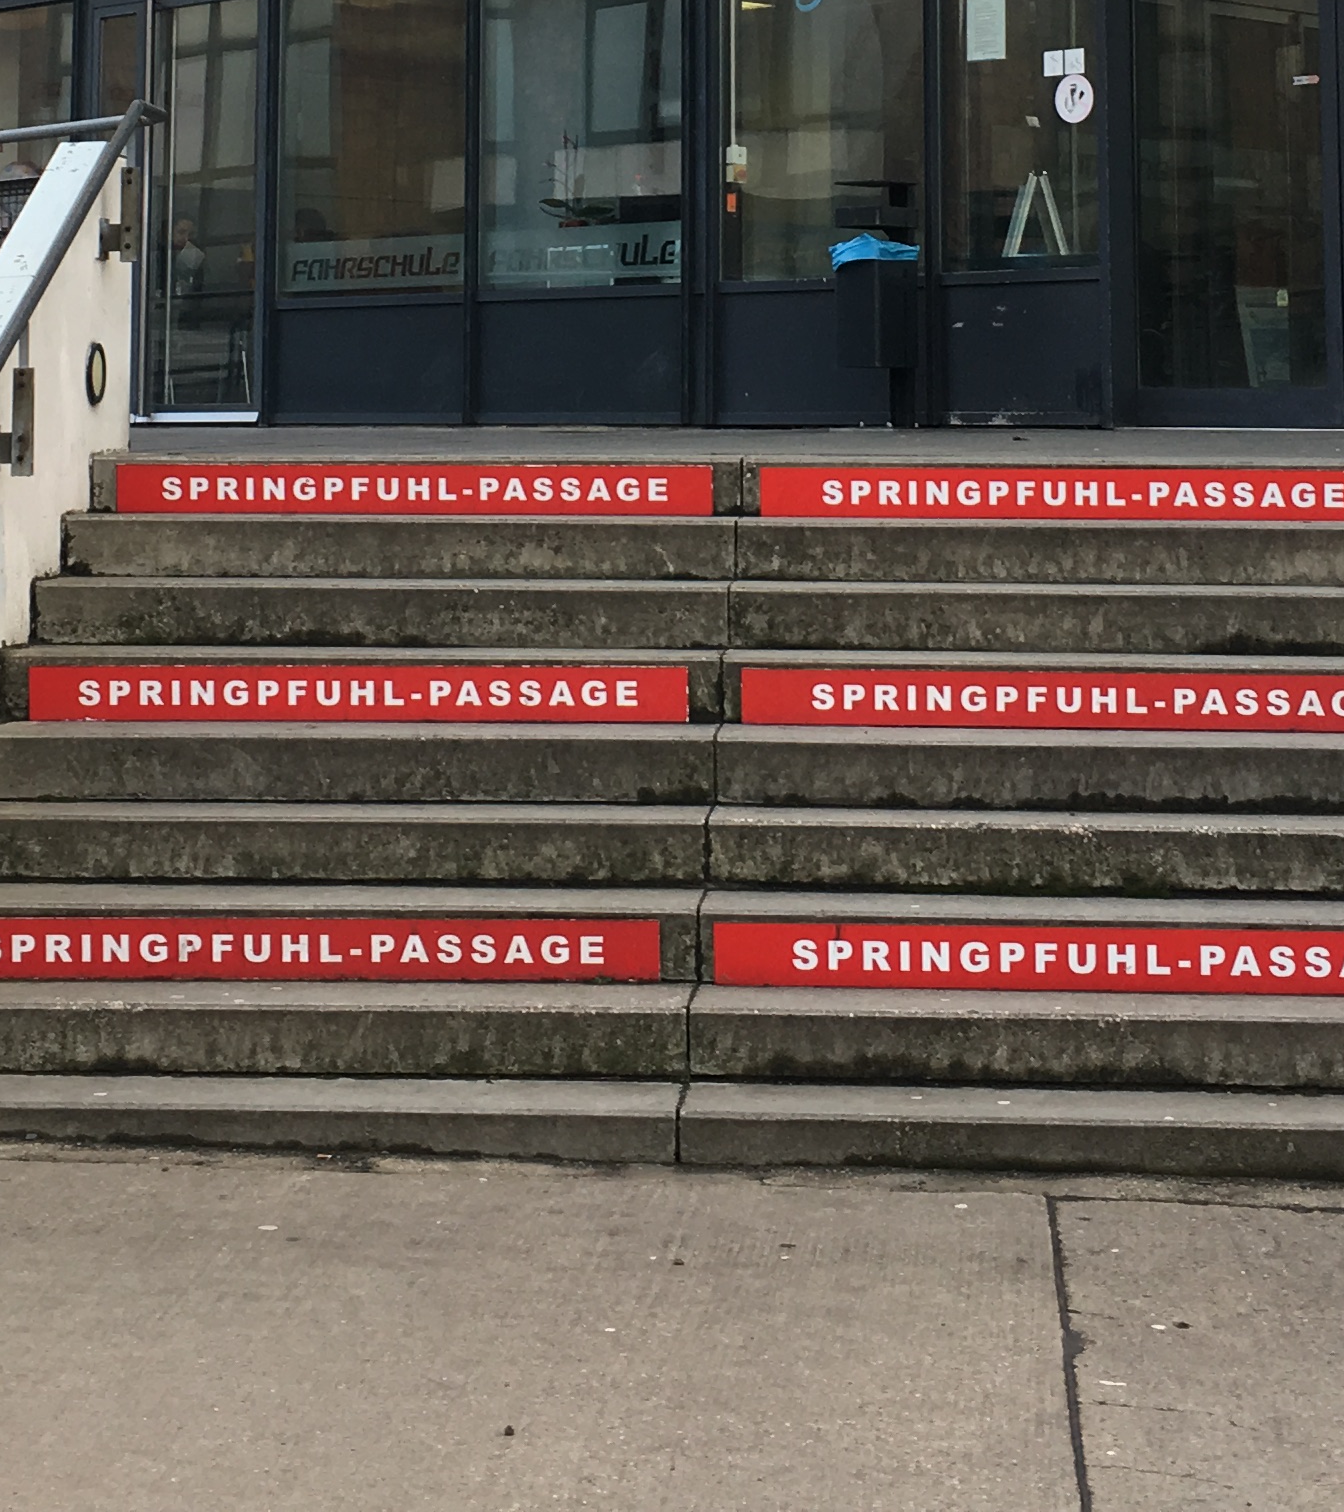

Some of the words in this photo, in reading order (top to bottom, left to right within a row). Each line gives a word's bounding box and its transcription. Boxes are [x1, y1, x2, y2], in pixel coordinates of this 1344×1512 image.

[162, 476, 668, 502] SPRINGPFUHL-PASSAGE
[822, 479, 1344, 509] SPRINGPFUHL-PASSAGE
[78, 679, 639, 707] SPRINGPFUHL-PASSAGE
